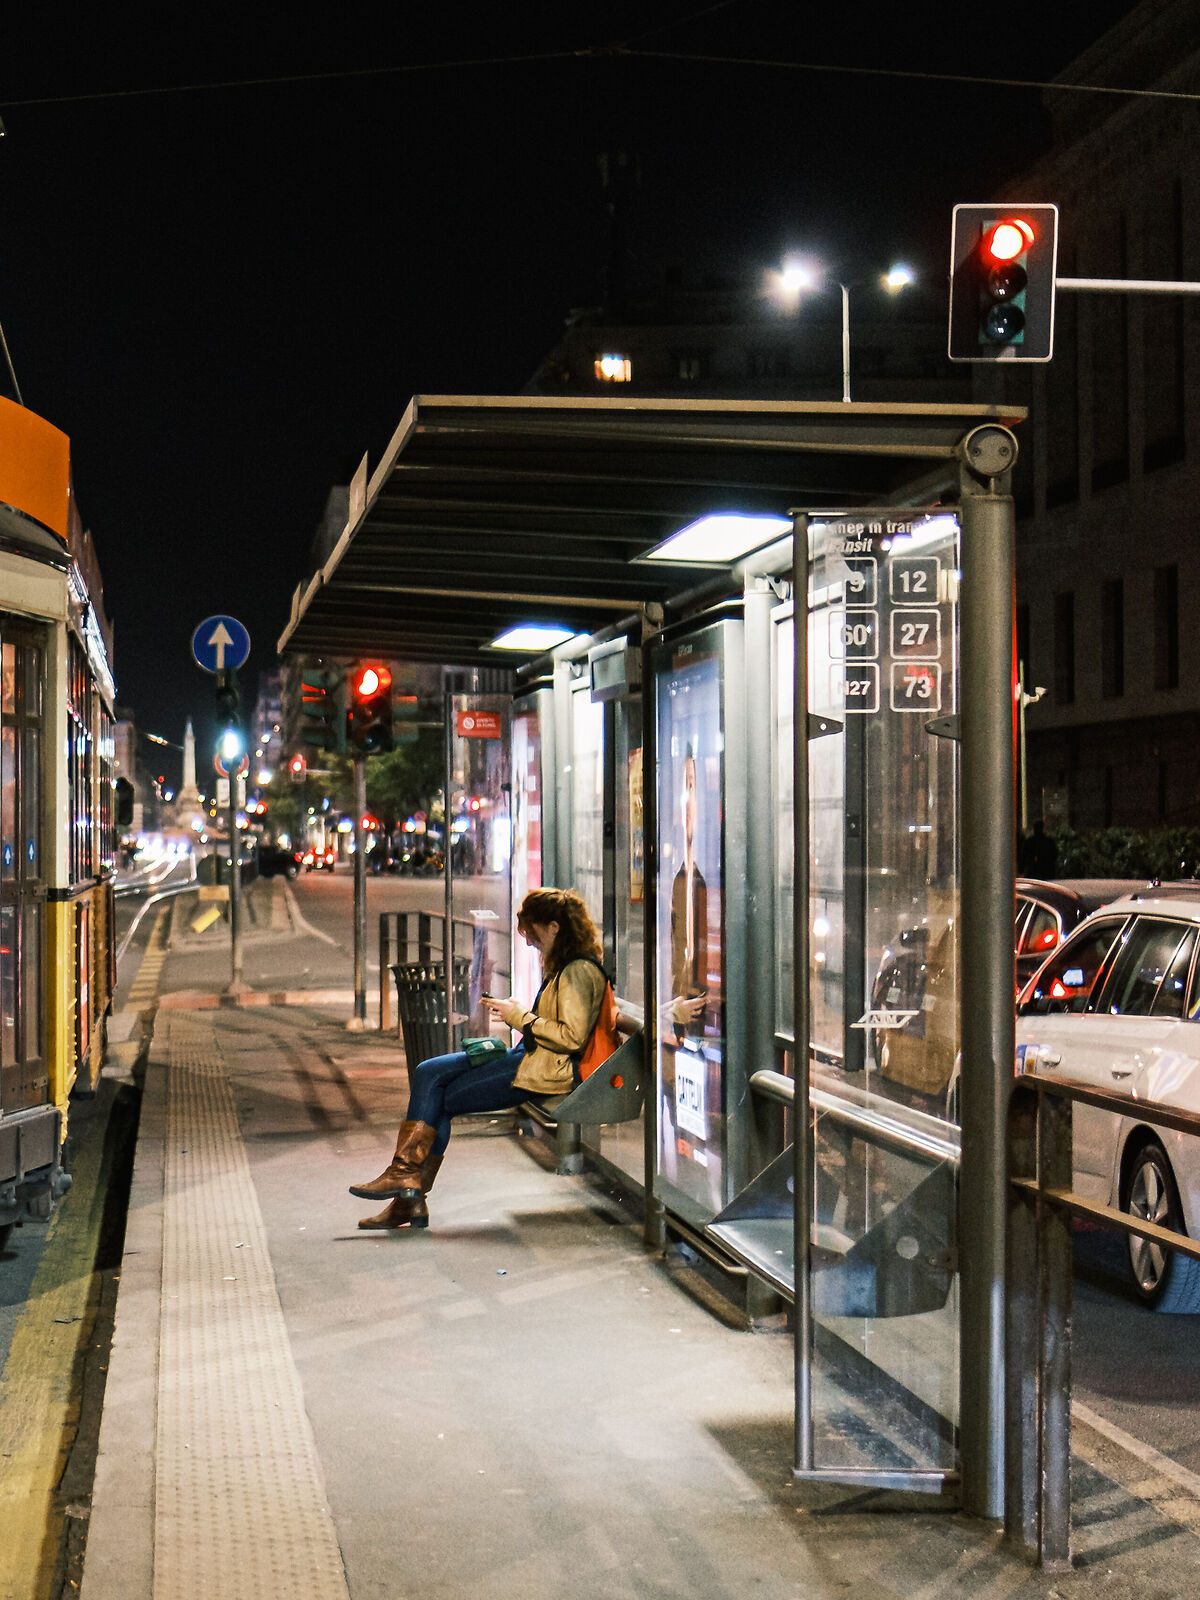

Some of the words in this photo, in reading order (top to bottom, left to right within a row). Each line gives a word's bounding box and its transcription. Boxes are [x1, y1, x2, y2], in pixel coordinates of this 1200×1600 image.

[899, 570, 928, 593] 12
[841, 623, 868, 646] 60
[900, 623, 930, 646] 27
[903, 675, 932, 698] 73
